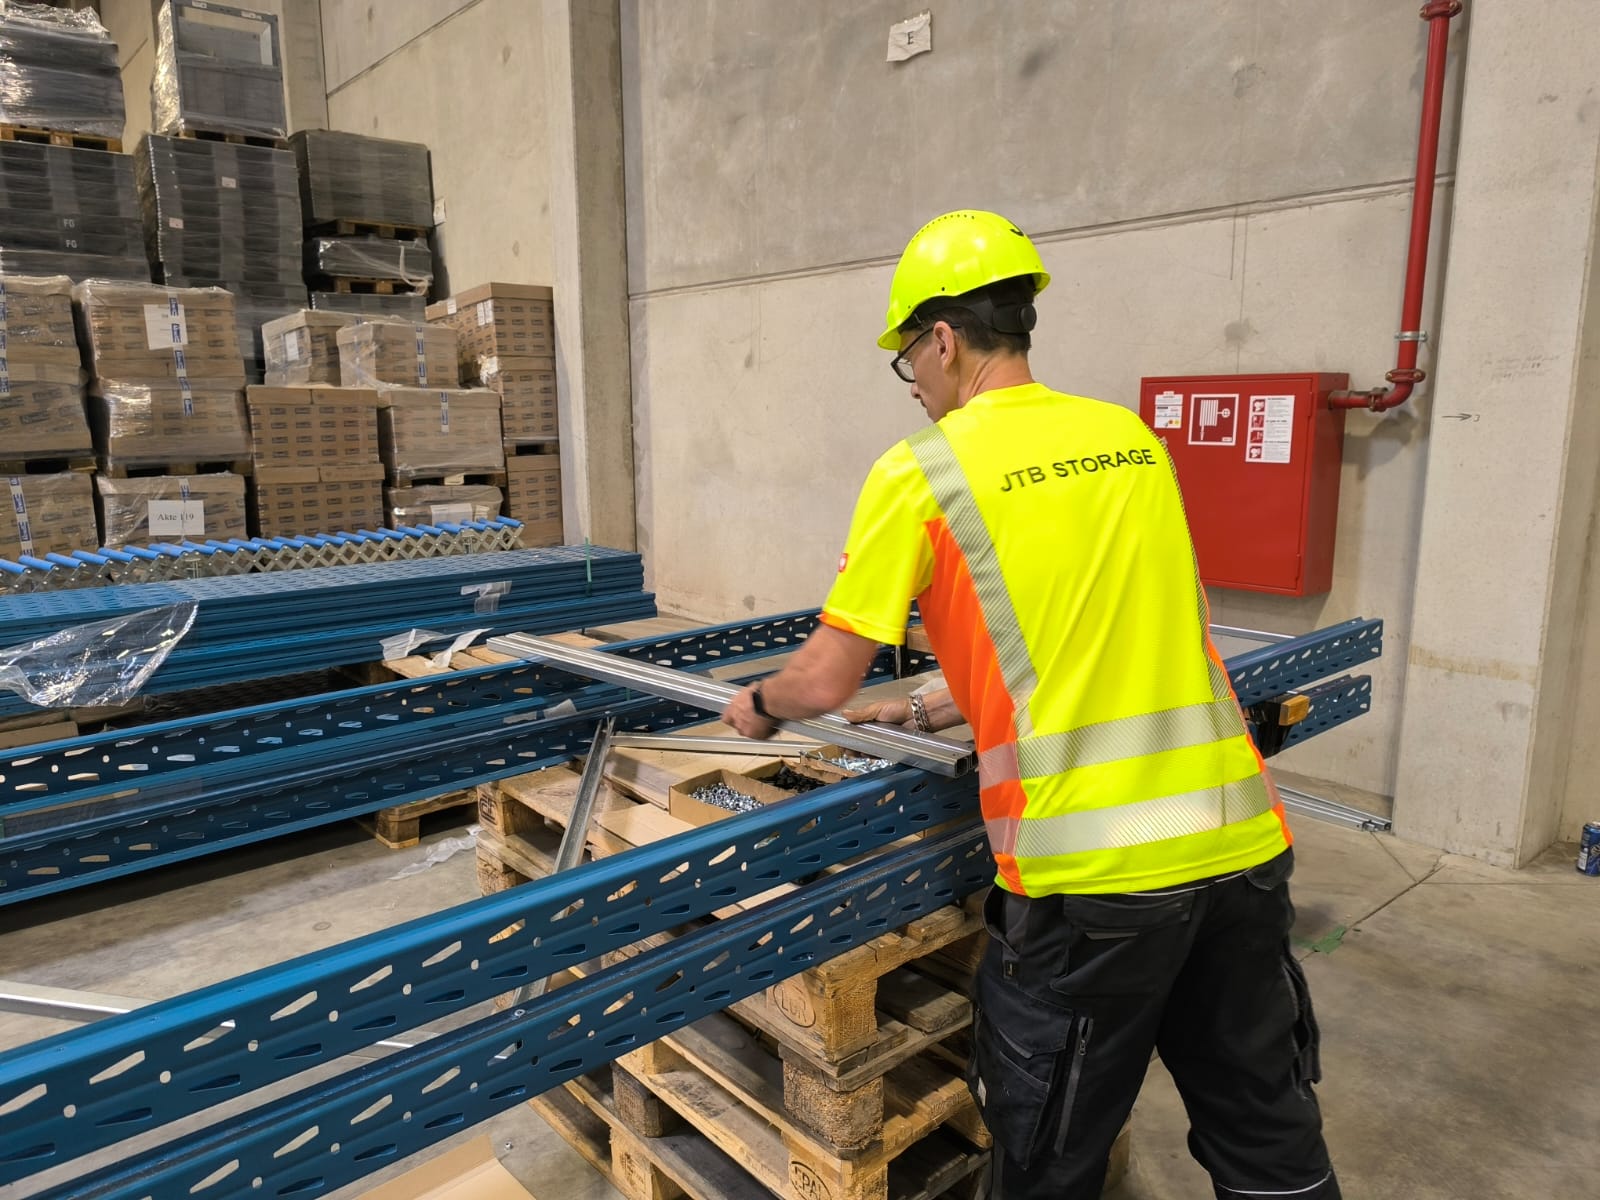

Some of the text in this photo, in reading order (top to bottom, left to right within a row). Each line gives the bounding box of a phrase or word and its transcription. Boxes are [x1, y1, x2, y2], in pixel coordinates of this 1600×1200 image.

[1000, 448, 1157, 492] JTB STORAGE
[157, 513, 177, 521] Akte
